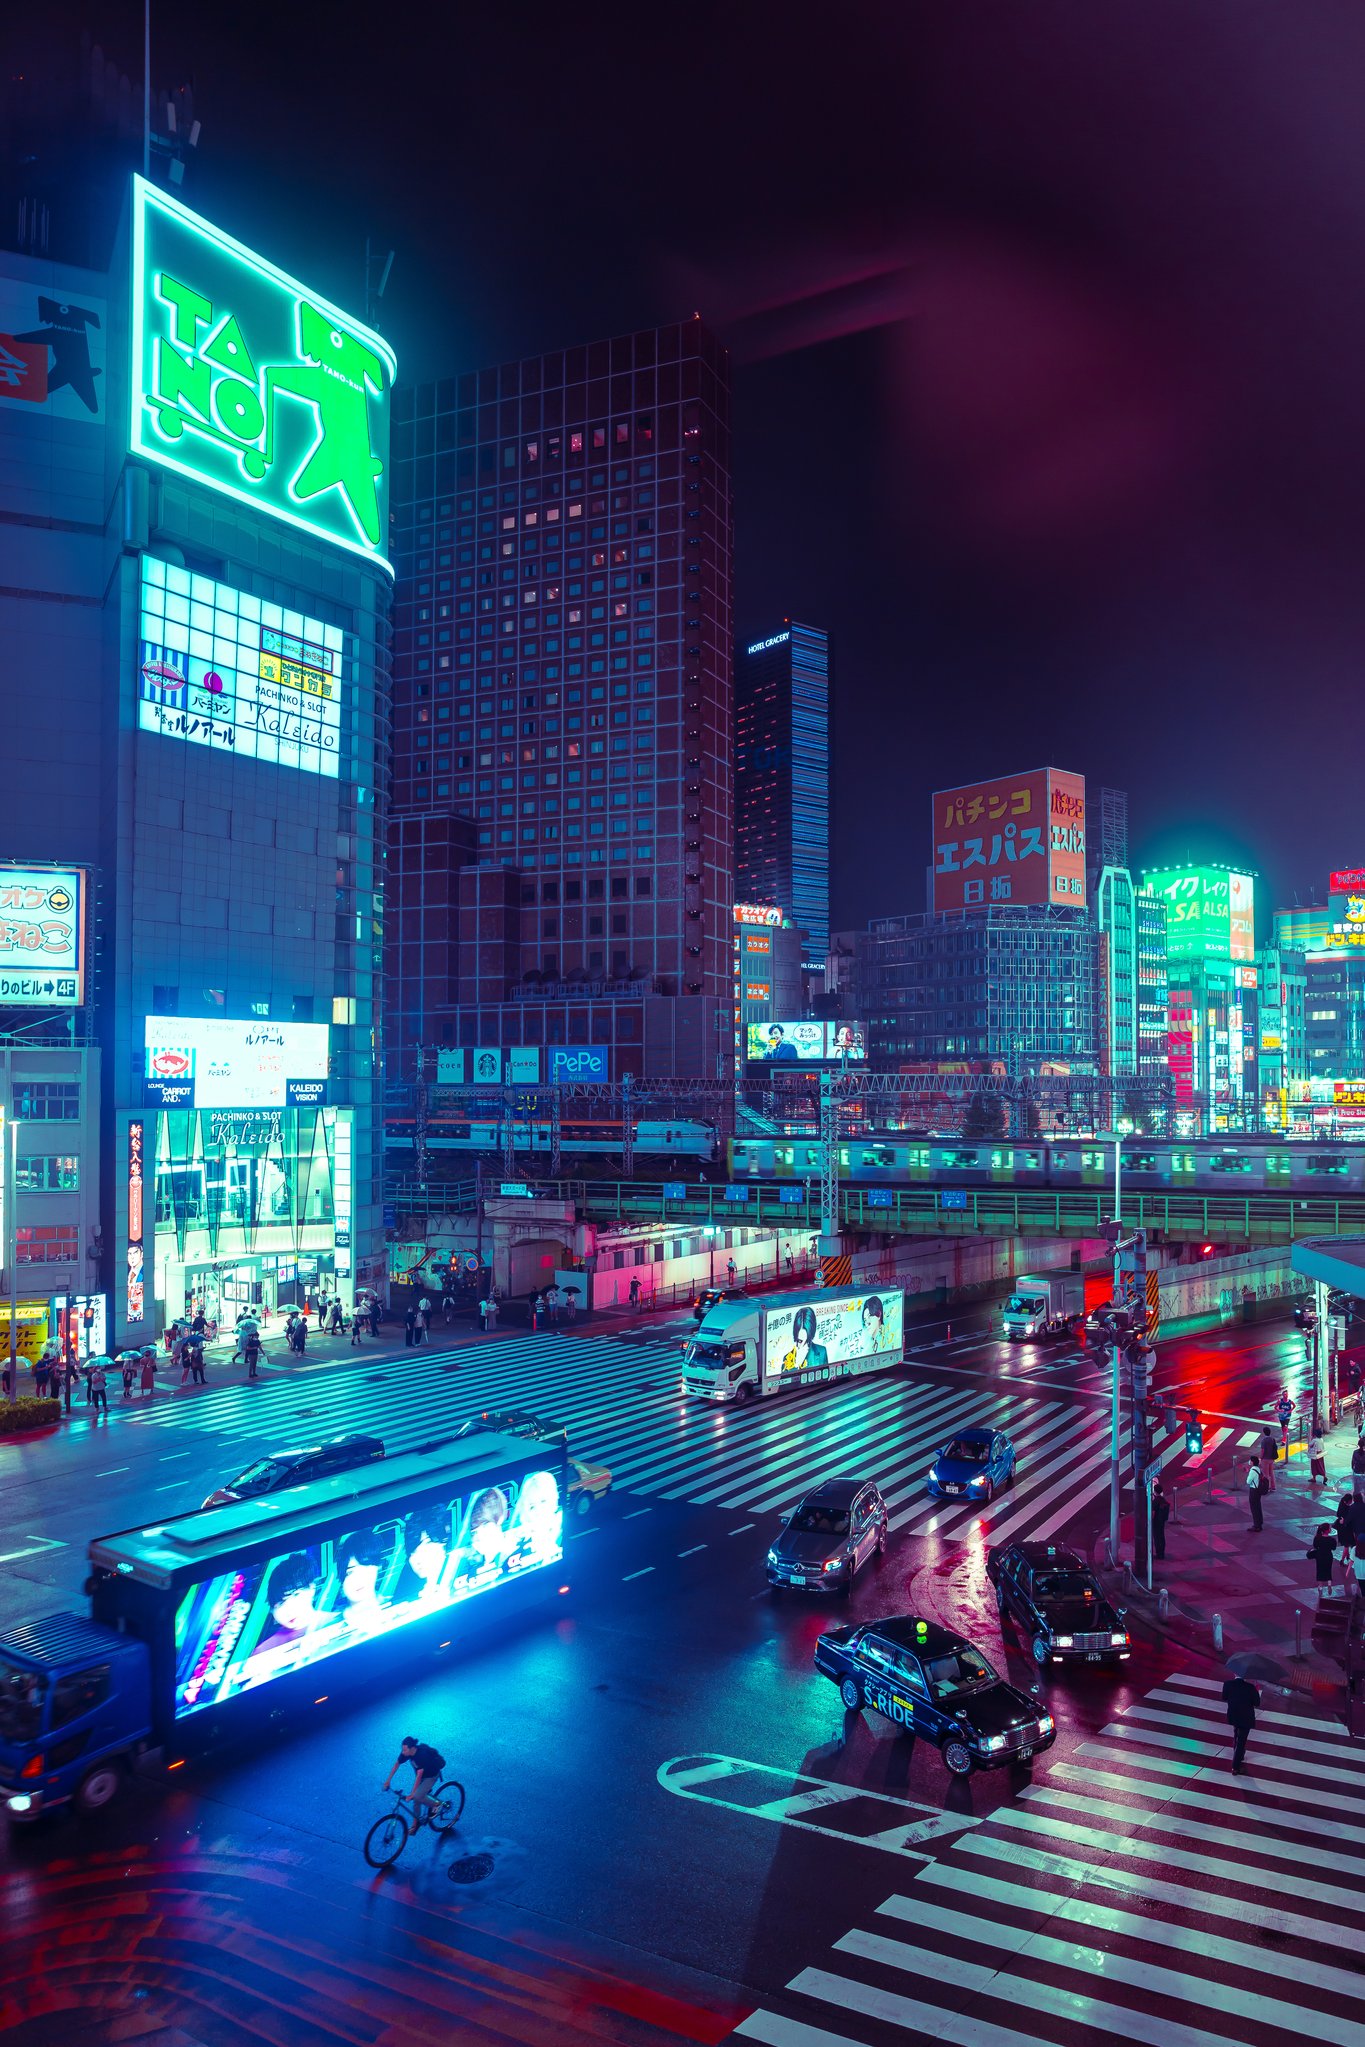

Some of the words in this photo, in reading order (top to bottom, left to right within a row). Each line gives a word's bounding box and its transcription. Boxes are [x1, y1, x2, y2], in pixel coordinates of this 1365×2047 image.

[322, 363, 364, 393] TANO-kun
[748, 641, 765, 655] HOTEL
[765, 631, 790, 647] GRACERY
[192, 696, 231, 715] バーミヤン
[255, 685, 298, 706] PACHINKO
[300, 700, 306, 708] &
[307, 701, 327, 715] SLOT
[944, 788, 1032, 829] パチンコ
[1051, 788, 1085, 820] パチンコ
[1051, 822, 1086, 855] エスパス
[935, 822, 1046, 874] エスパス
[1202, 878, 1228, 897] レイク
[740, 906, 768, 915] カラオケ
[1203, 901, 1229, 919] ALSA
[1142, 920, 1164, 928] SHISHA
[747, 940, 770, 948] カラオケ
[58, 980, 75, 996] 4F
[245, 1034, 285, 1046] ルノアール
[554, 1052, 602, 1072] PePe
[162, 1087, 192, 1096] CARROT
[290, 1084, 324, 1092] KALEIDO
[295, 1093, 318, 1102] VISION
[212, 1112, 254, 1122] PACHINKO
[254, 1112, 260, 1120] &
[262, 1112, 282, 1120] SLOT
[816, 1304, 836, 1316] BREAKING
[864, 1686, 915, 1731] S.RIDE
